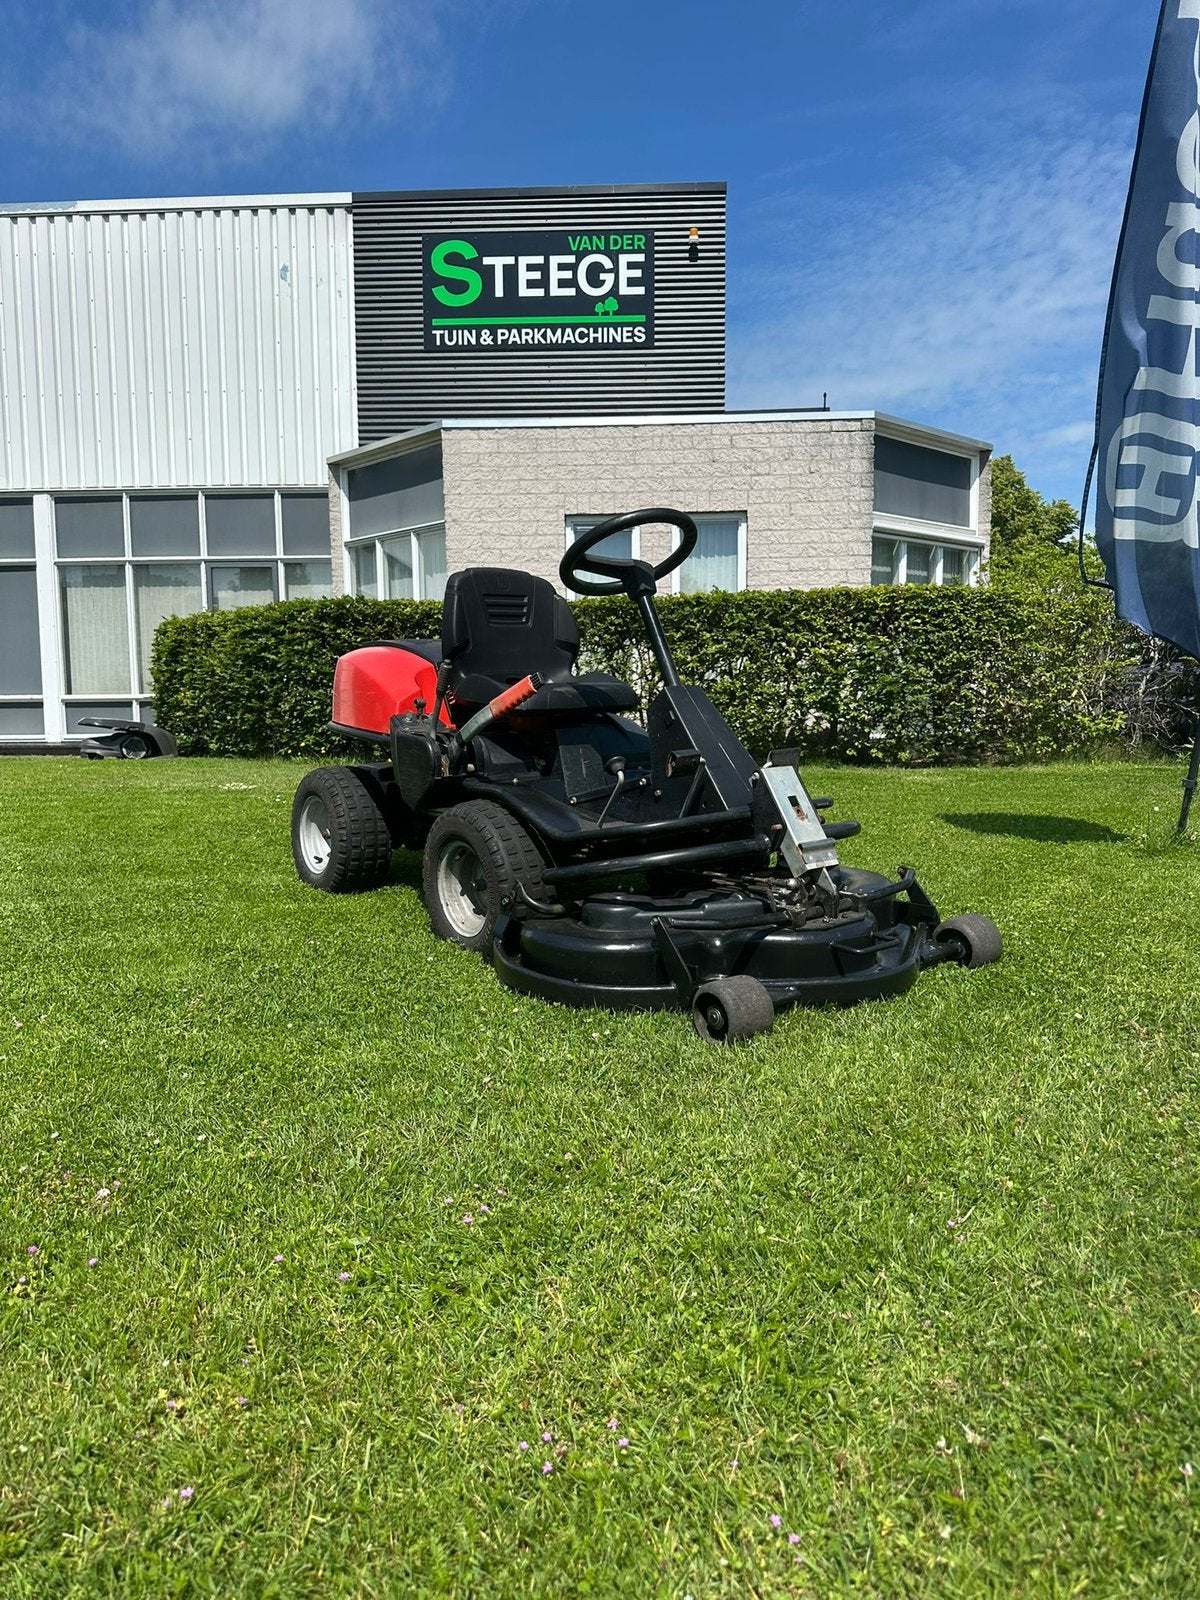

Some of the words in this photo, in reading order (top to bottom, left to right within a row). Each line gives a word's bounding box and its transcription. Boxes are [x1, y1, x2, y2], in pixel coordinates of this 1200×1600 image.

[568, 235, 605, 251] VAN
[609, 234, 646, 250] DER
[431, 239, 646, 307] STEEGE
[432, 329, 477, 346] TUIN
[479, 328, 494, 345] &
[497, 326, 646, 345] PARKMACHINES
